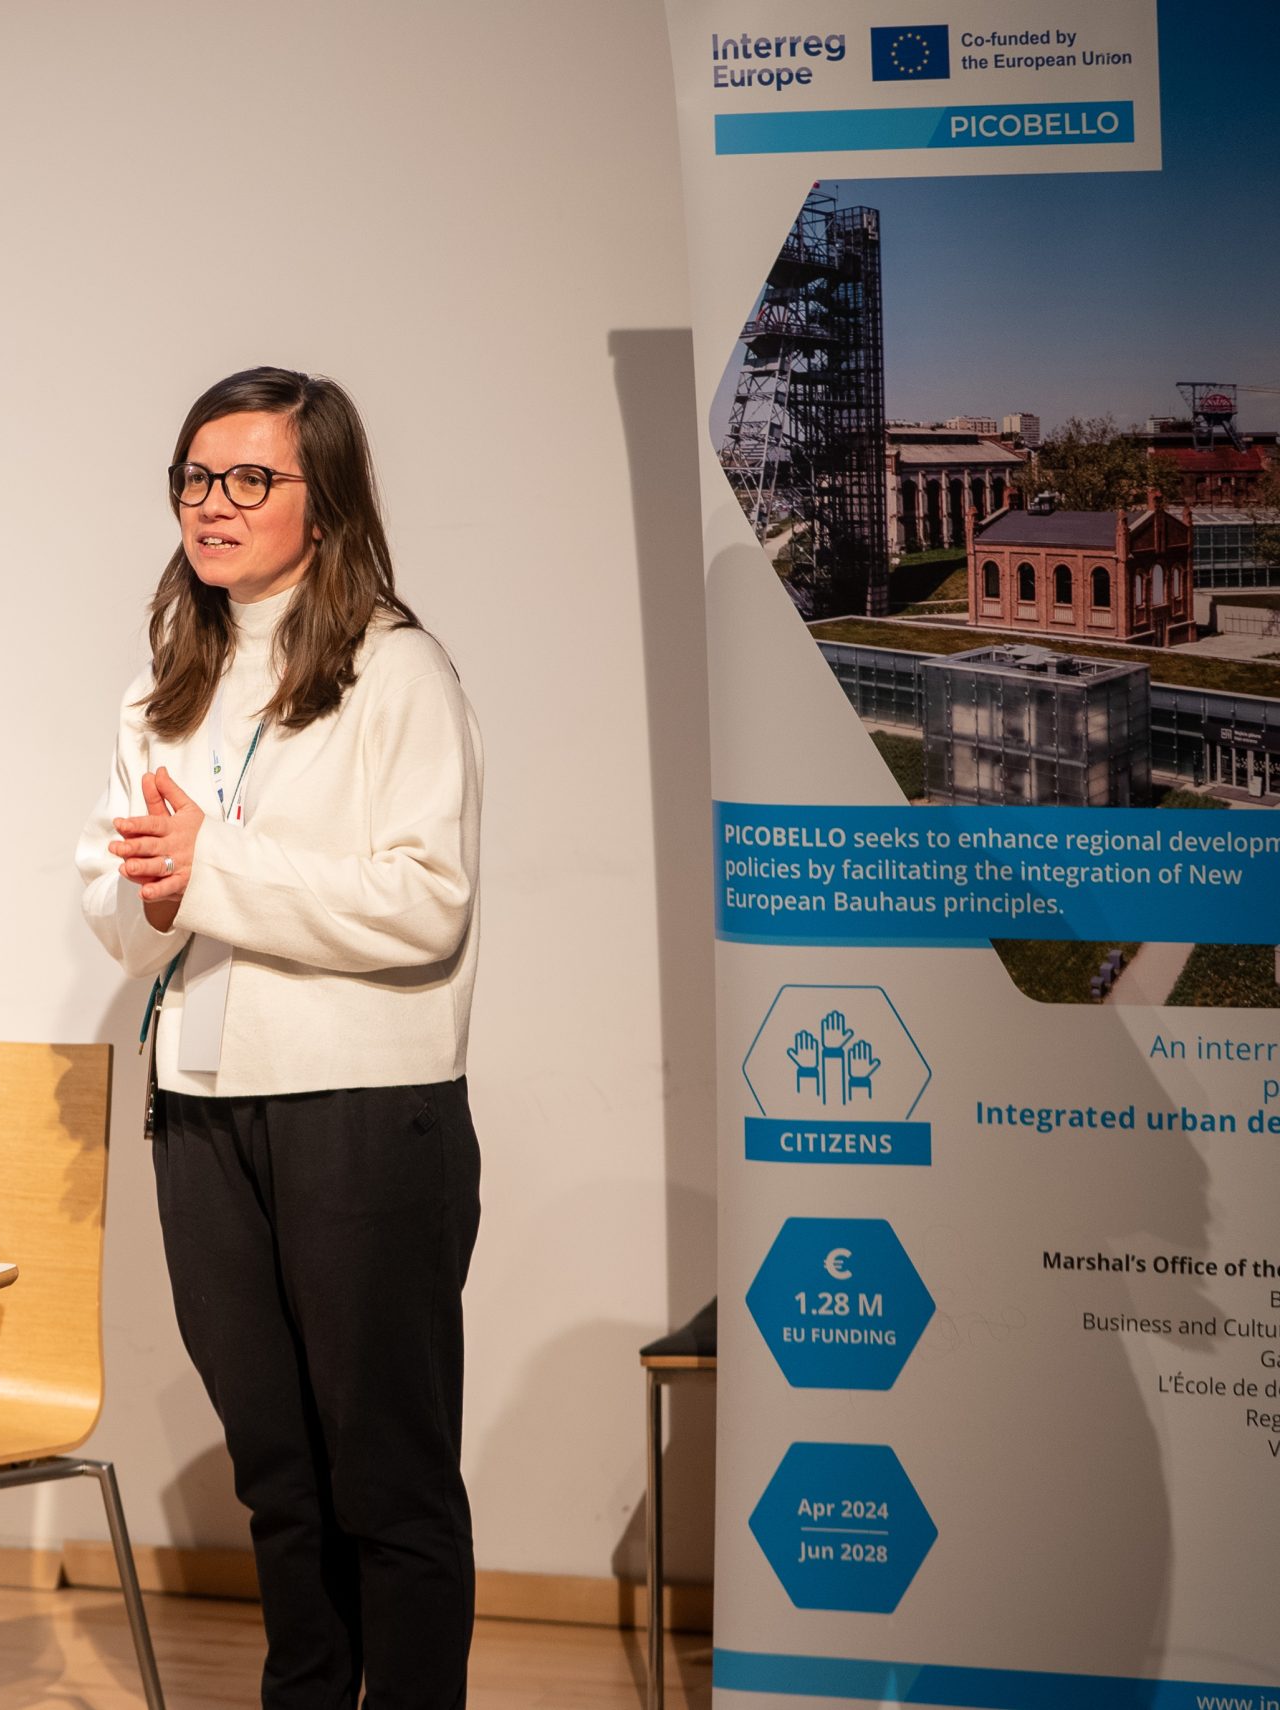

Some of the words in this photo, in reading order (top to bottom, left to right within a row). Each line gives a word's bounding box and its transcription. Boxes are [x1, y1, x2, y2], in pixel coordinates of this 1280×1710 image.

[713, 34, 845, 61] Interreg
[961, 31, 1052, 48] Co-funded
[1056, 30, 1077, 48] by
[962, 55, 988, 69] the
[994, 53, 1076, 71] European
[1083, 51, 1132, 65] Union
[714, 66, 812, 91] Europe
[951, 112, 1118, 138] PICOBELLO
[726, 824, 846, 847] PICOBELLO
[854, 827, 919, 848] seeks
[927, 830, 950, 848] to
[959, 828, 1058, 849] enhance
[1067, 830, 1160, 855] regional
[726, 857, 800, 880] policies
[809, 859, 835, 885] by
[842, 859, 967, 885] facilitating
[975, 860, 1012, 880] the
[1021, 862, 1150, 888] integration
[1159, 864, 1182, 883] of
[1190, 865, 1242, 884] New
[727, 888, 825, 914] European
[835, 891, 936, 911] Bauhaus
[944, 892, 1064, 918] principles.
[1150, 1035, 1185, 1058] An
[1198, 1036, 1278, 1061] interr
[977, 1102, 1135, 1133] Integrated
[1147, 1107, 1235, 1132] urban
[780, 1132, 893, 1154] CITIZENS
[824, 1247, 853, 1281] €
[1044, 1252, 1145, 1272] Marshal's
[1153, 1256, 1217, 1275] Office
[1225, 1259, 1247, 1276] of
[1253, 1260, 1280, 1278] th
[795, 1292, 849, 1315] 1.28
[859, 1293, 882, 1316] M
[783, 1327, 805, 1342] EU
[812, 1328, 896, 1345] FUNDING
[1084, 1313, 1172, 1333] Business
[1179, 1317, 1216, 1336] and
[1224, 1319, 1280, 1338] Cultu
[1159, 1371, 1227, 1396] L'École
[1233, 1378, 1257, 1397] de
[1265, 1380, 1280, 1397] d
[798, 1499, 835, 1520] Apr
[841, 1500, 888, 1519] 2024
[798, 1542, 833, 1562] Jun
[841, 1544, 887, 1562] 2028
